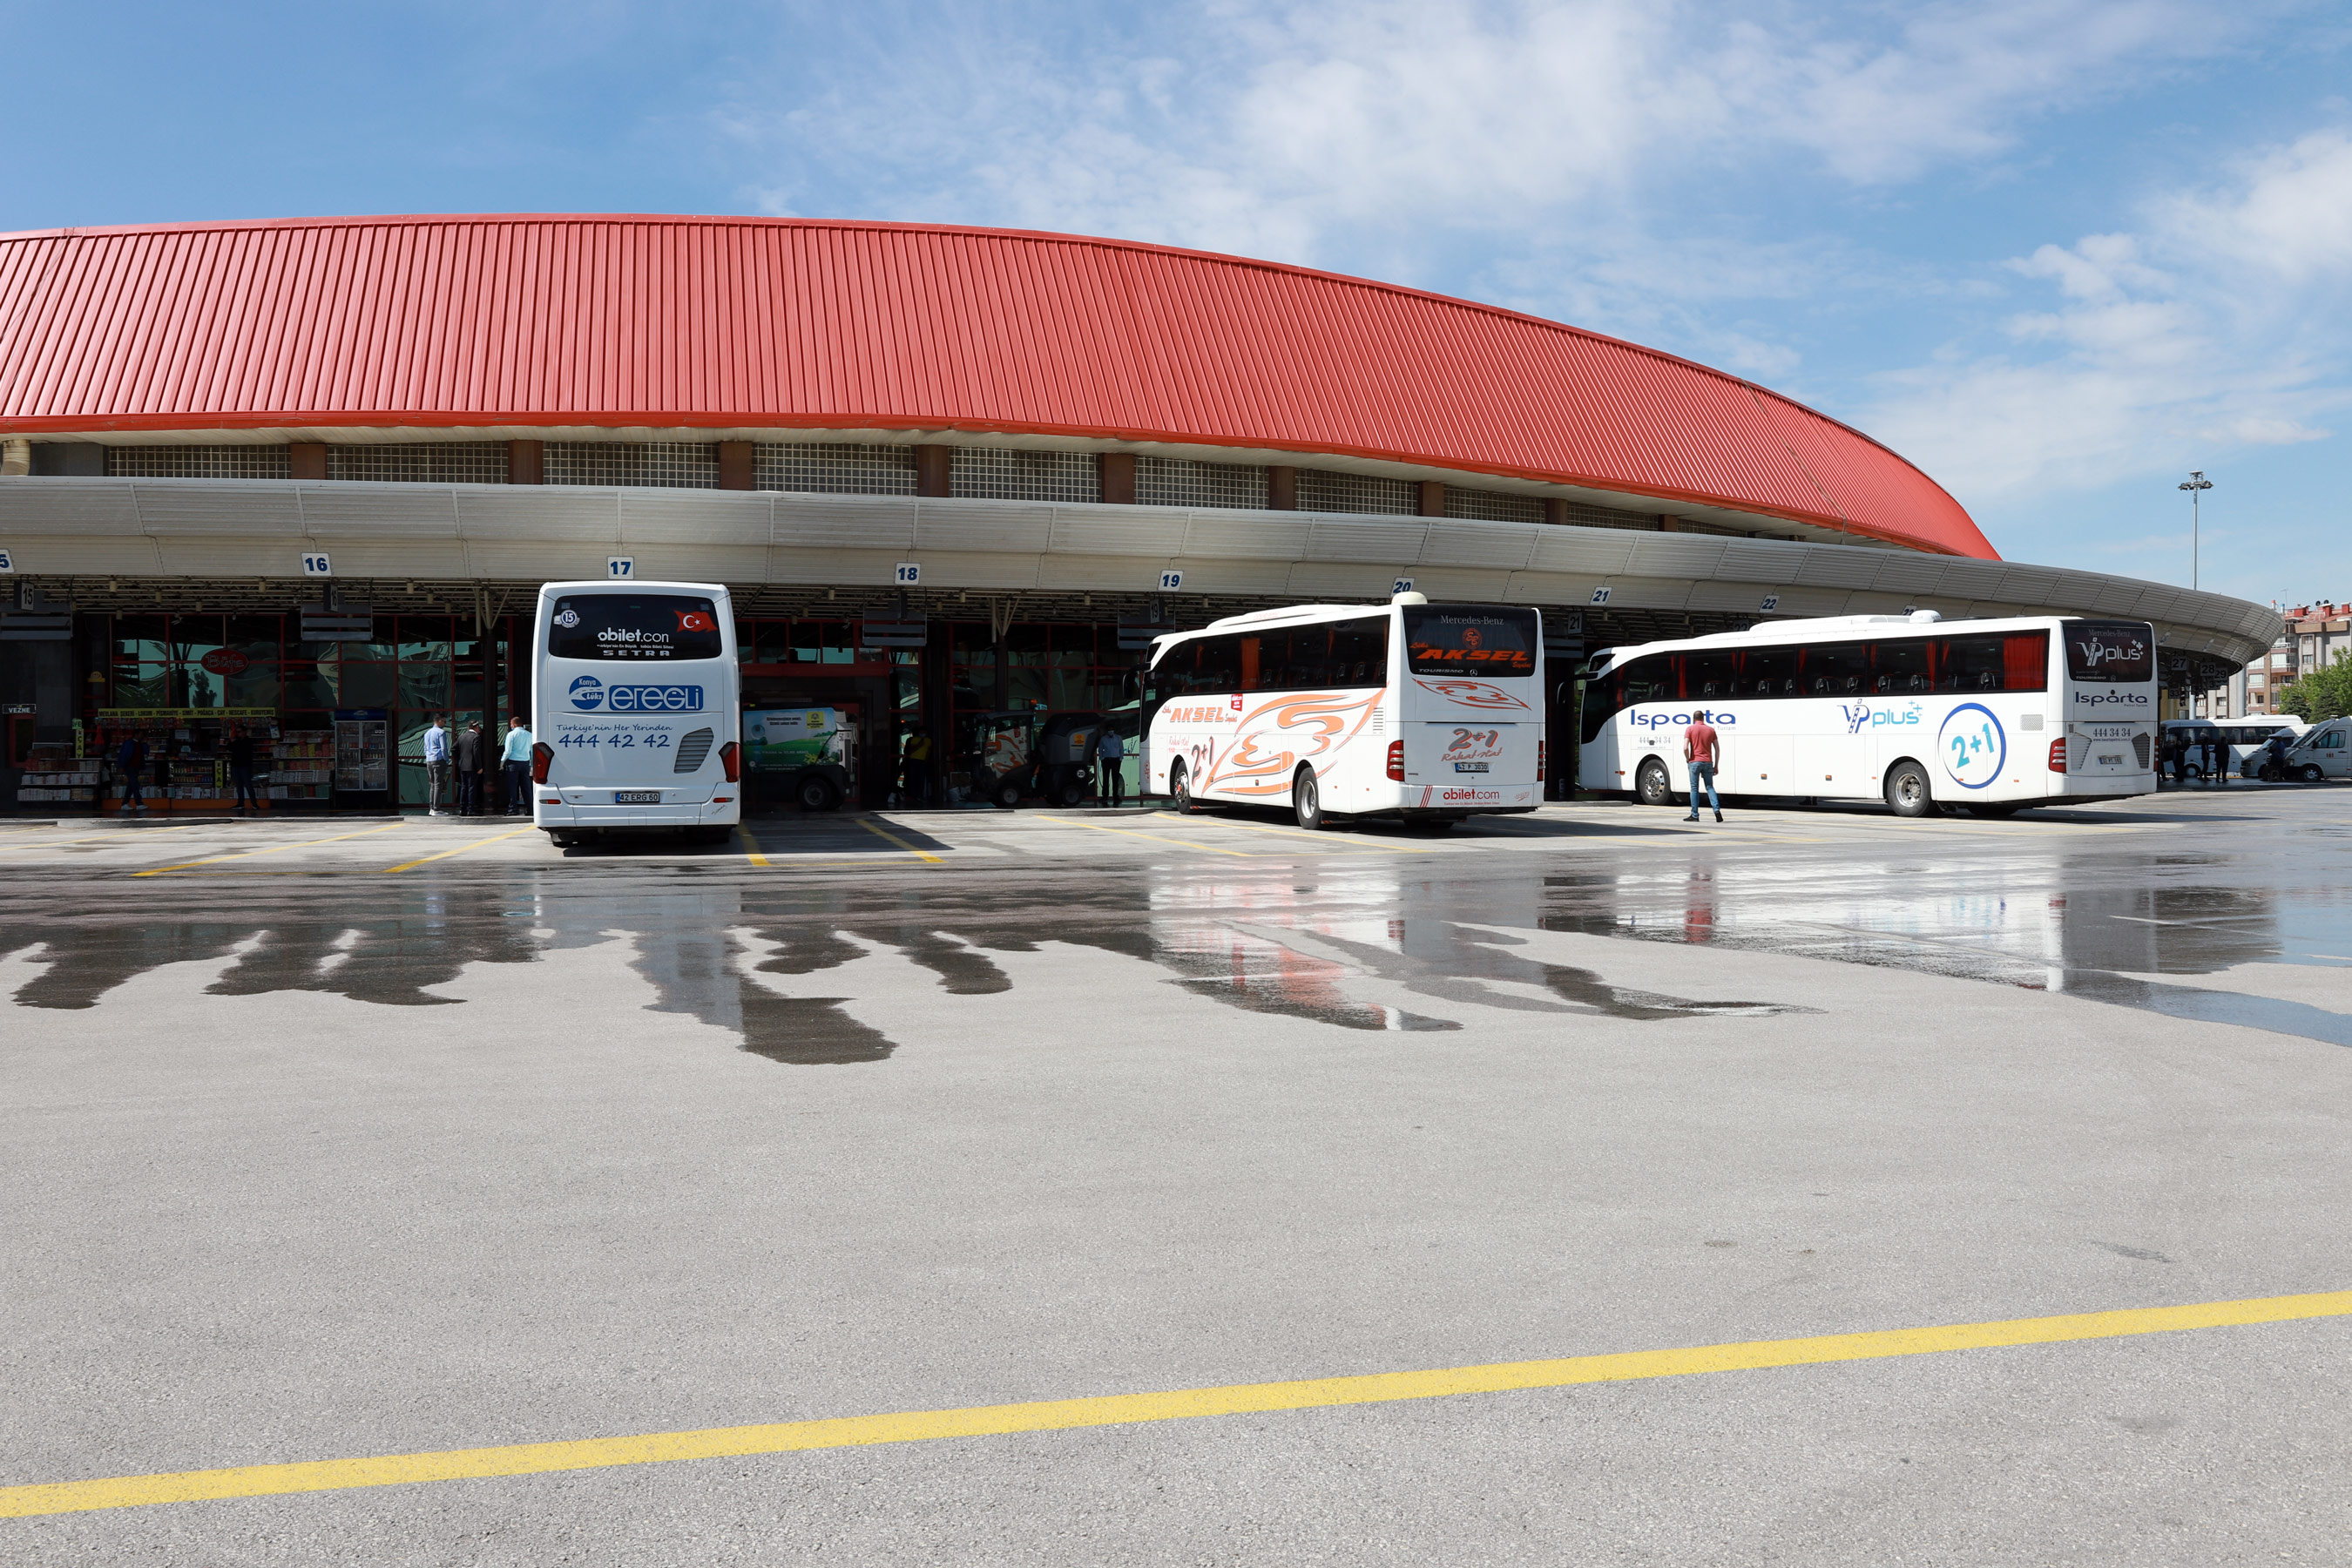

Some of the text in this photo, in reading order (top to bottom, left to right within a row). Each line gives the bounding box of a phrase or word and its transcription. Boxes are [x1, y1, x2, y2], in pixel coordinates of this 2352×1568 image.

[305, 558, 328, 571] 16
[610, 561, 631, 575] 17
[898, 567, 917, 580] 18
[1162, 575, 1179, 587] 19
[1393, 581, 1411, 593] 20
[23, 588, 33, 605] 15
[1592, 591, 1609, 602] 21
[1151, 603, 1159, 618] 19
[1761, 598, 1777, 610] 22
[565, 612, 574, 623] 15
[1441, 615, 1504, 625] Mercedes-Benz
[1570, 615, 1580, 630] 21
[2088, 628, 2131, 637] Mercedes-Benz
[1416, 649, 1529, 661] AKSEL
[2105, 645, 2141, 663] plus
[206, 653, 245, 673] Büfe
[2173, 659, 2186, 668] 27
[2201, 664, 2215, 674] 28
[2214, 670, 2227, 679] 29
[578, 678, 597, 687] Konya
[2075, 691, 2148, 706] Isparta
[1169, 706, 1225, 723] AKSEL
[1872, 708, 1921, 727] plus
[556, 724, 612, 733] Türkiye'nin
[2092, 727, 2131, 737] 444 34 34
[558, 733, 671, 748] 444 42 42
[1448, 727, 1499, 753] 2+1
[1950, 722, 1995, 769] 2+1
[1443, 787, 1500, 800] obilet.com
